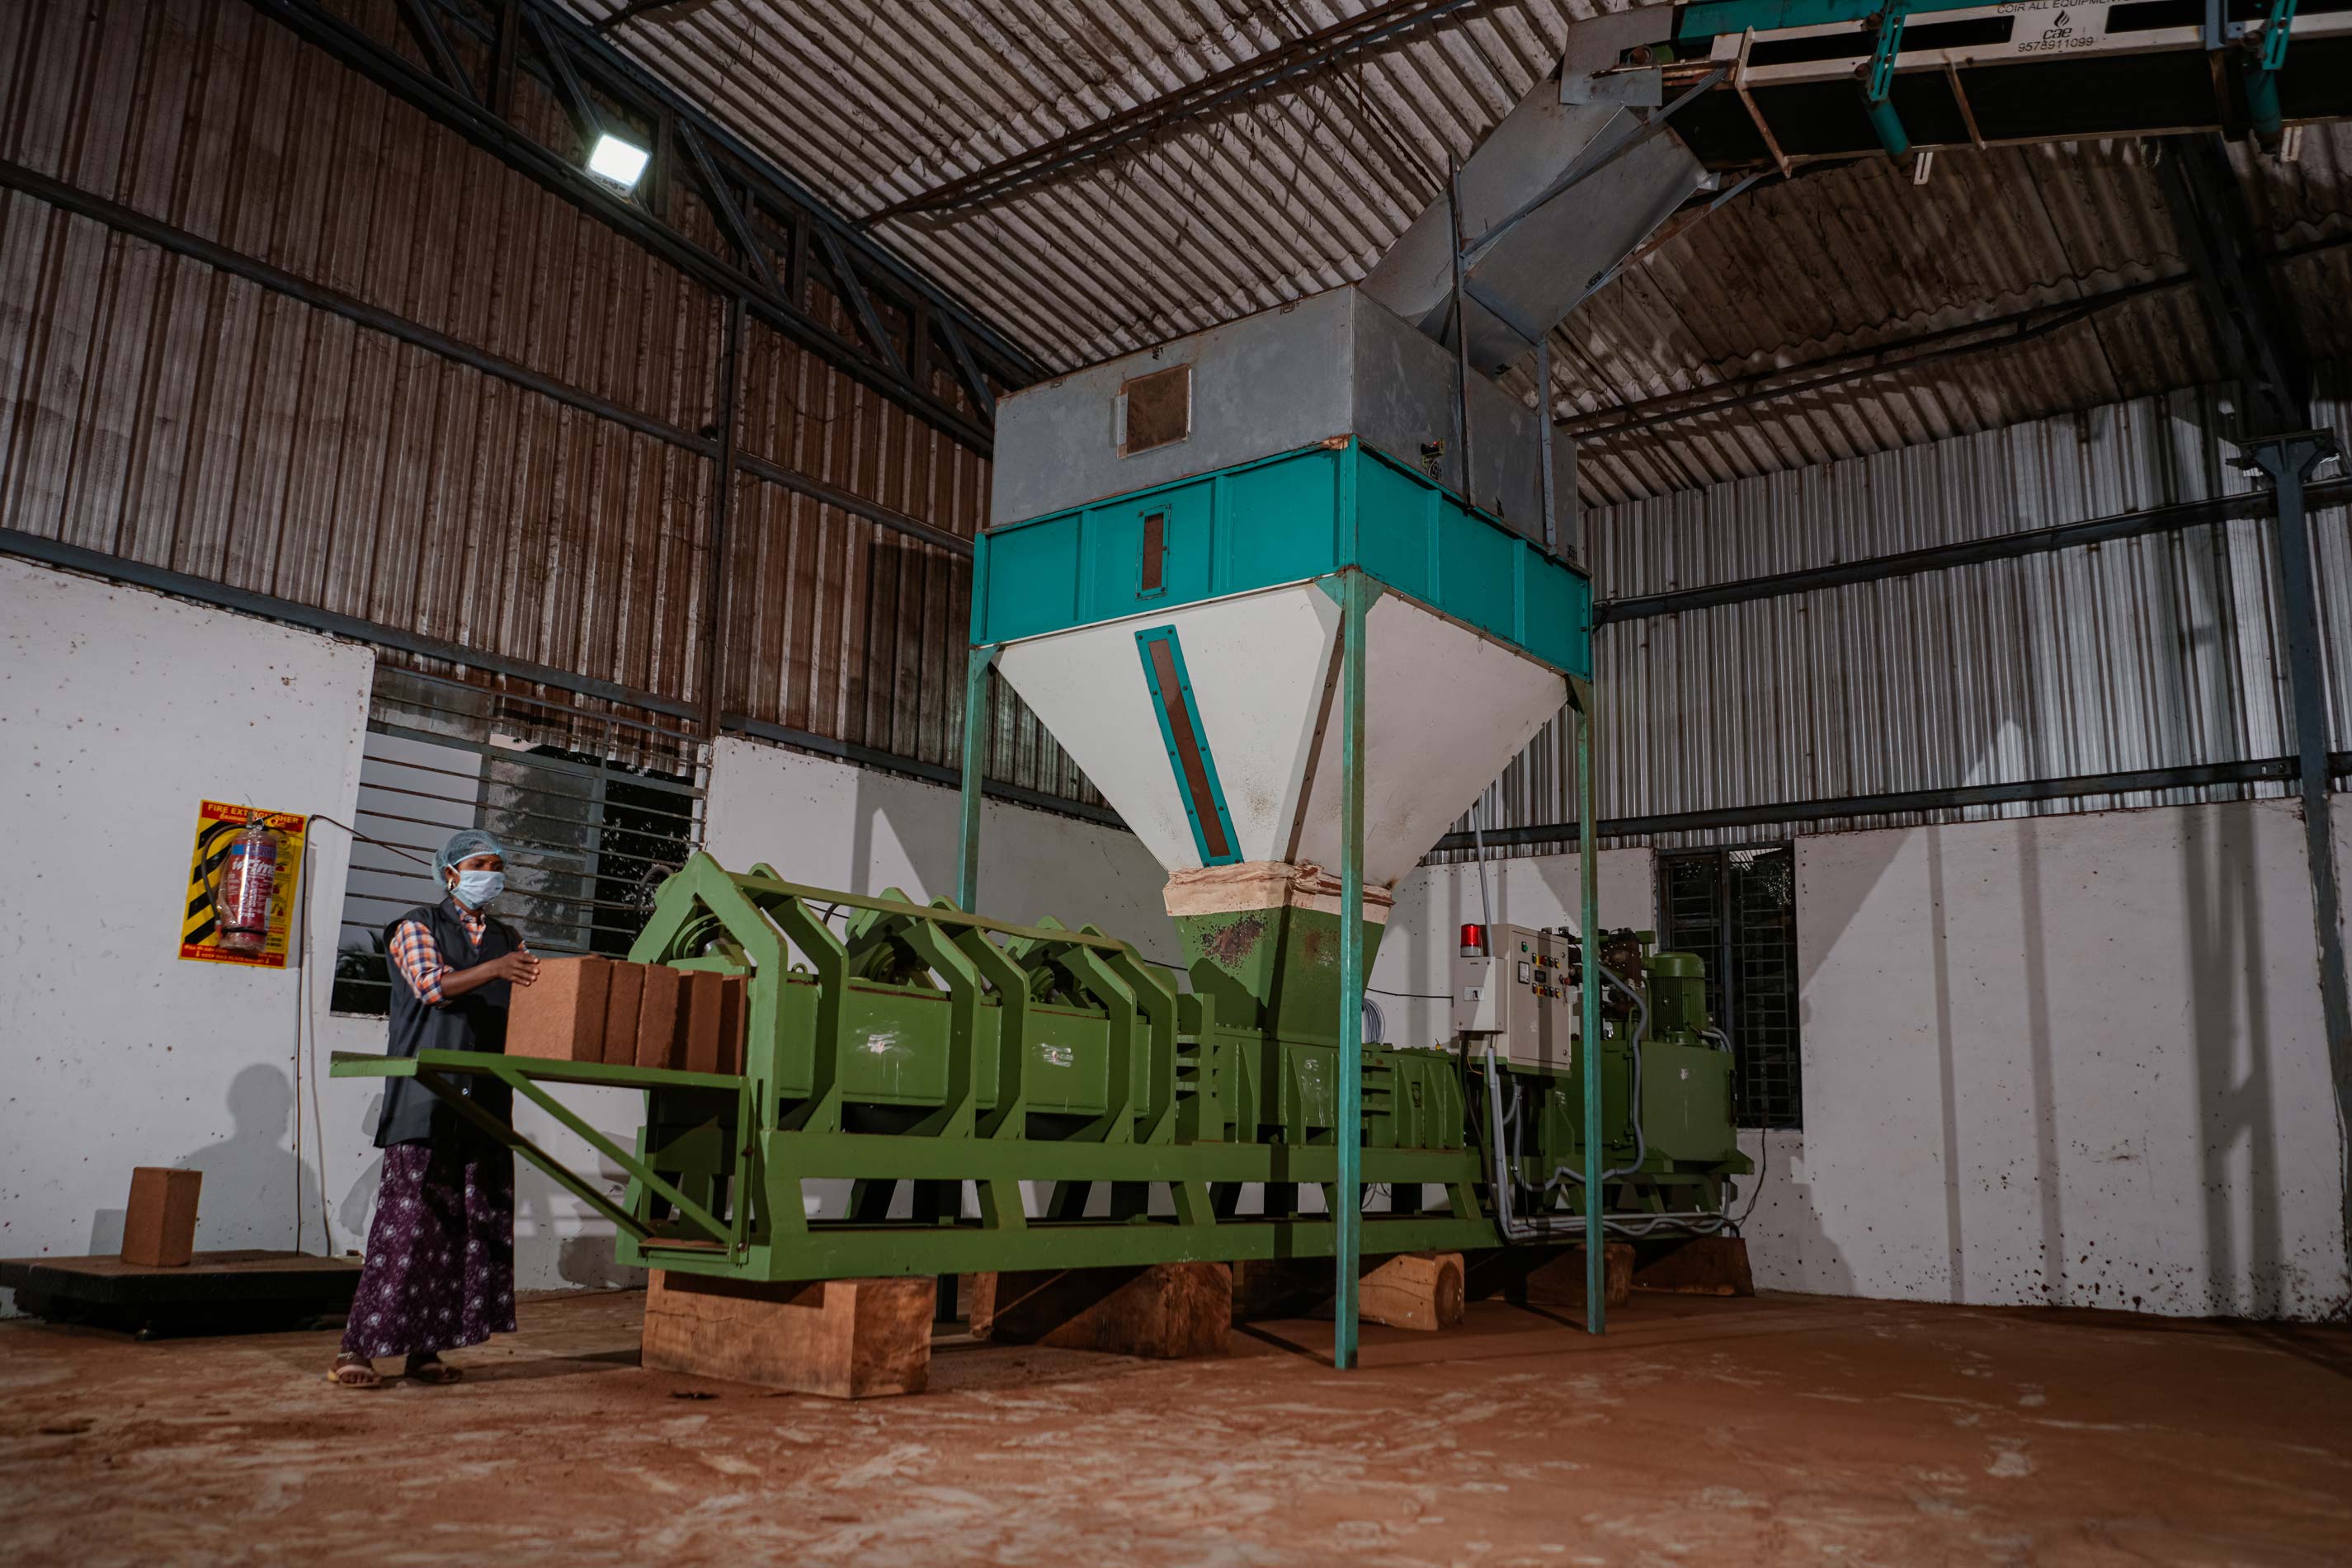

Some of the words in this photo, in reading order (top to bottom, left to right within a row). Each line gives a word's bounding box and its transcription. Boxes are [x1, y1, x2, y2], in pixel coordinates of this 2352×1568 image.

[1997, 4, 2025, 14] COIR
[2029, 1, 2048, 11] ALL
[2053, 0, 2128, 8] EQUIPM
[2043, 27, 2072, 40] cae
[2018, 37, 2094, 52] 9578911099
[208, 804, 229, 813] FIRE
[231, 808, 299, 823] EXTNGUSHER
